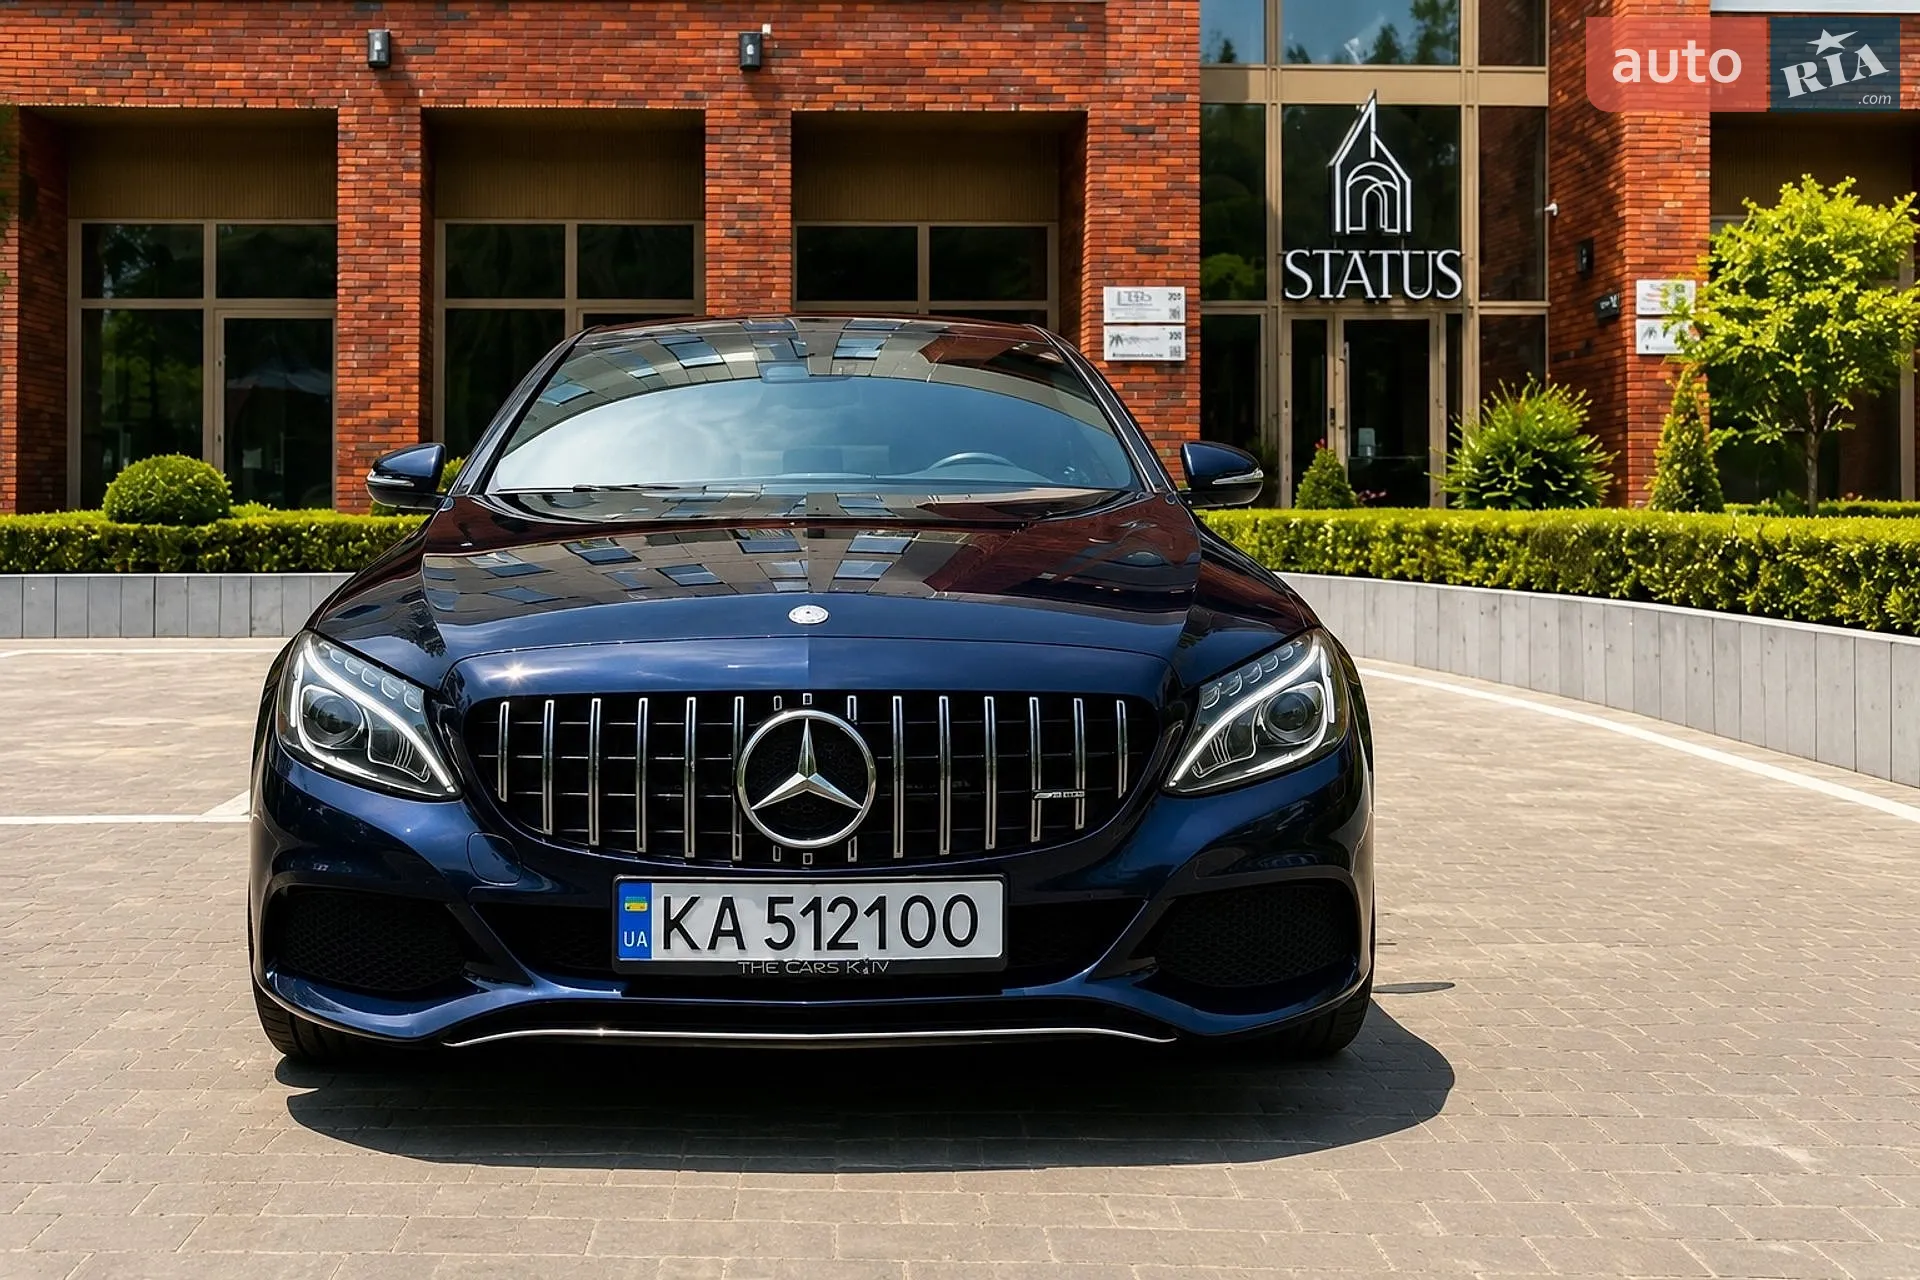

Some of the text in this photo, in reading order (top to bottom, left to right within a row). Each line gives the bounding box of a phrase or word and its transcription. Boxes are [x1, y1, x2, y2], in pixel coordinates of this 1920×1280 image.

[1284, 249, 1463, 299] STATUS
[623, 930, 648, 948] UA
[662, 895, 746, 951] KA
[737, 961, 779, 974] THE
[784, 961, 839, 974] CARS
